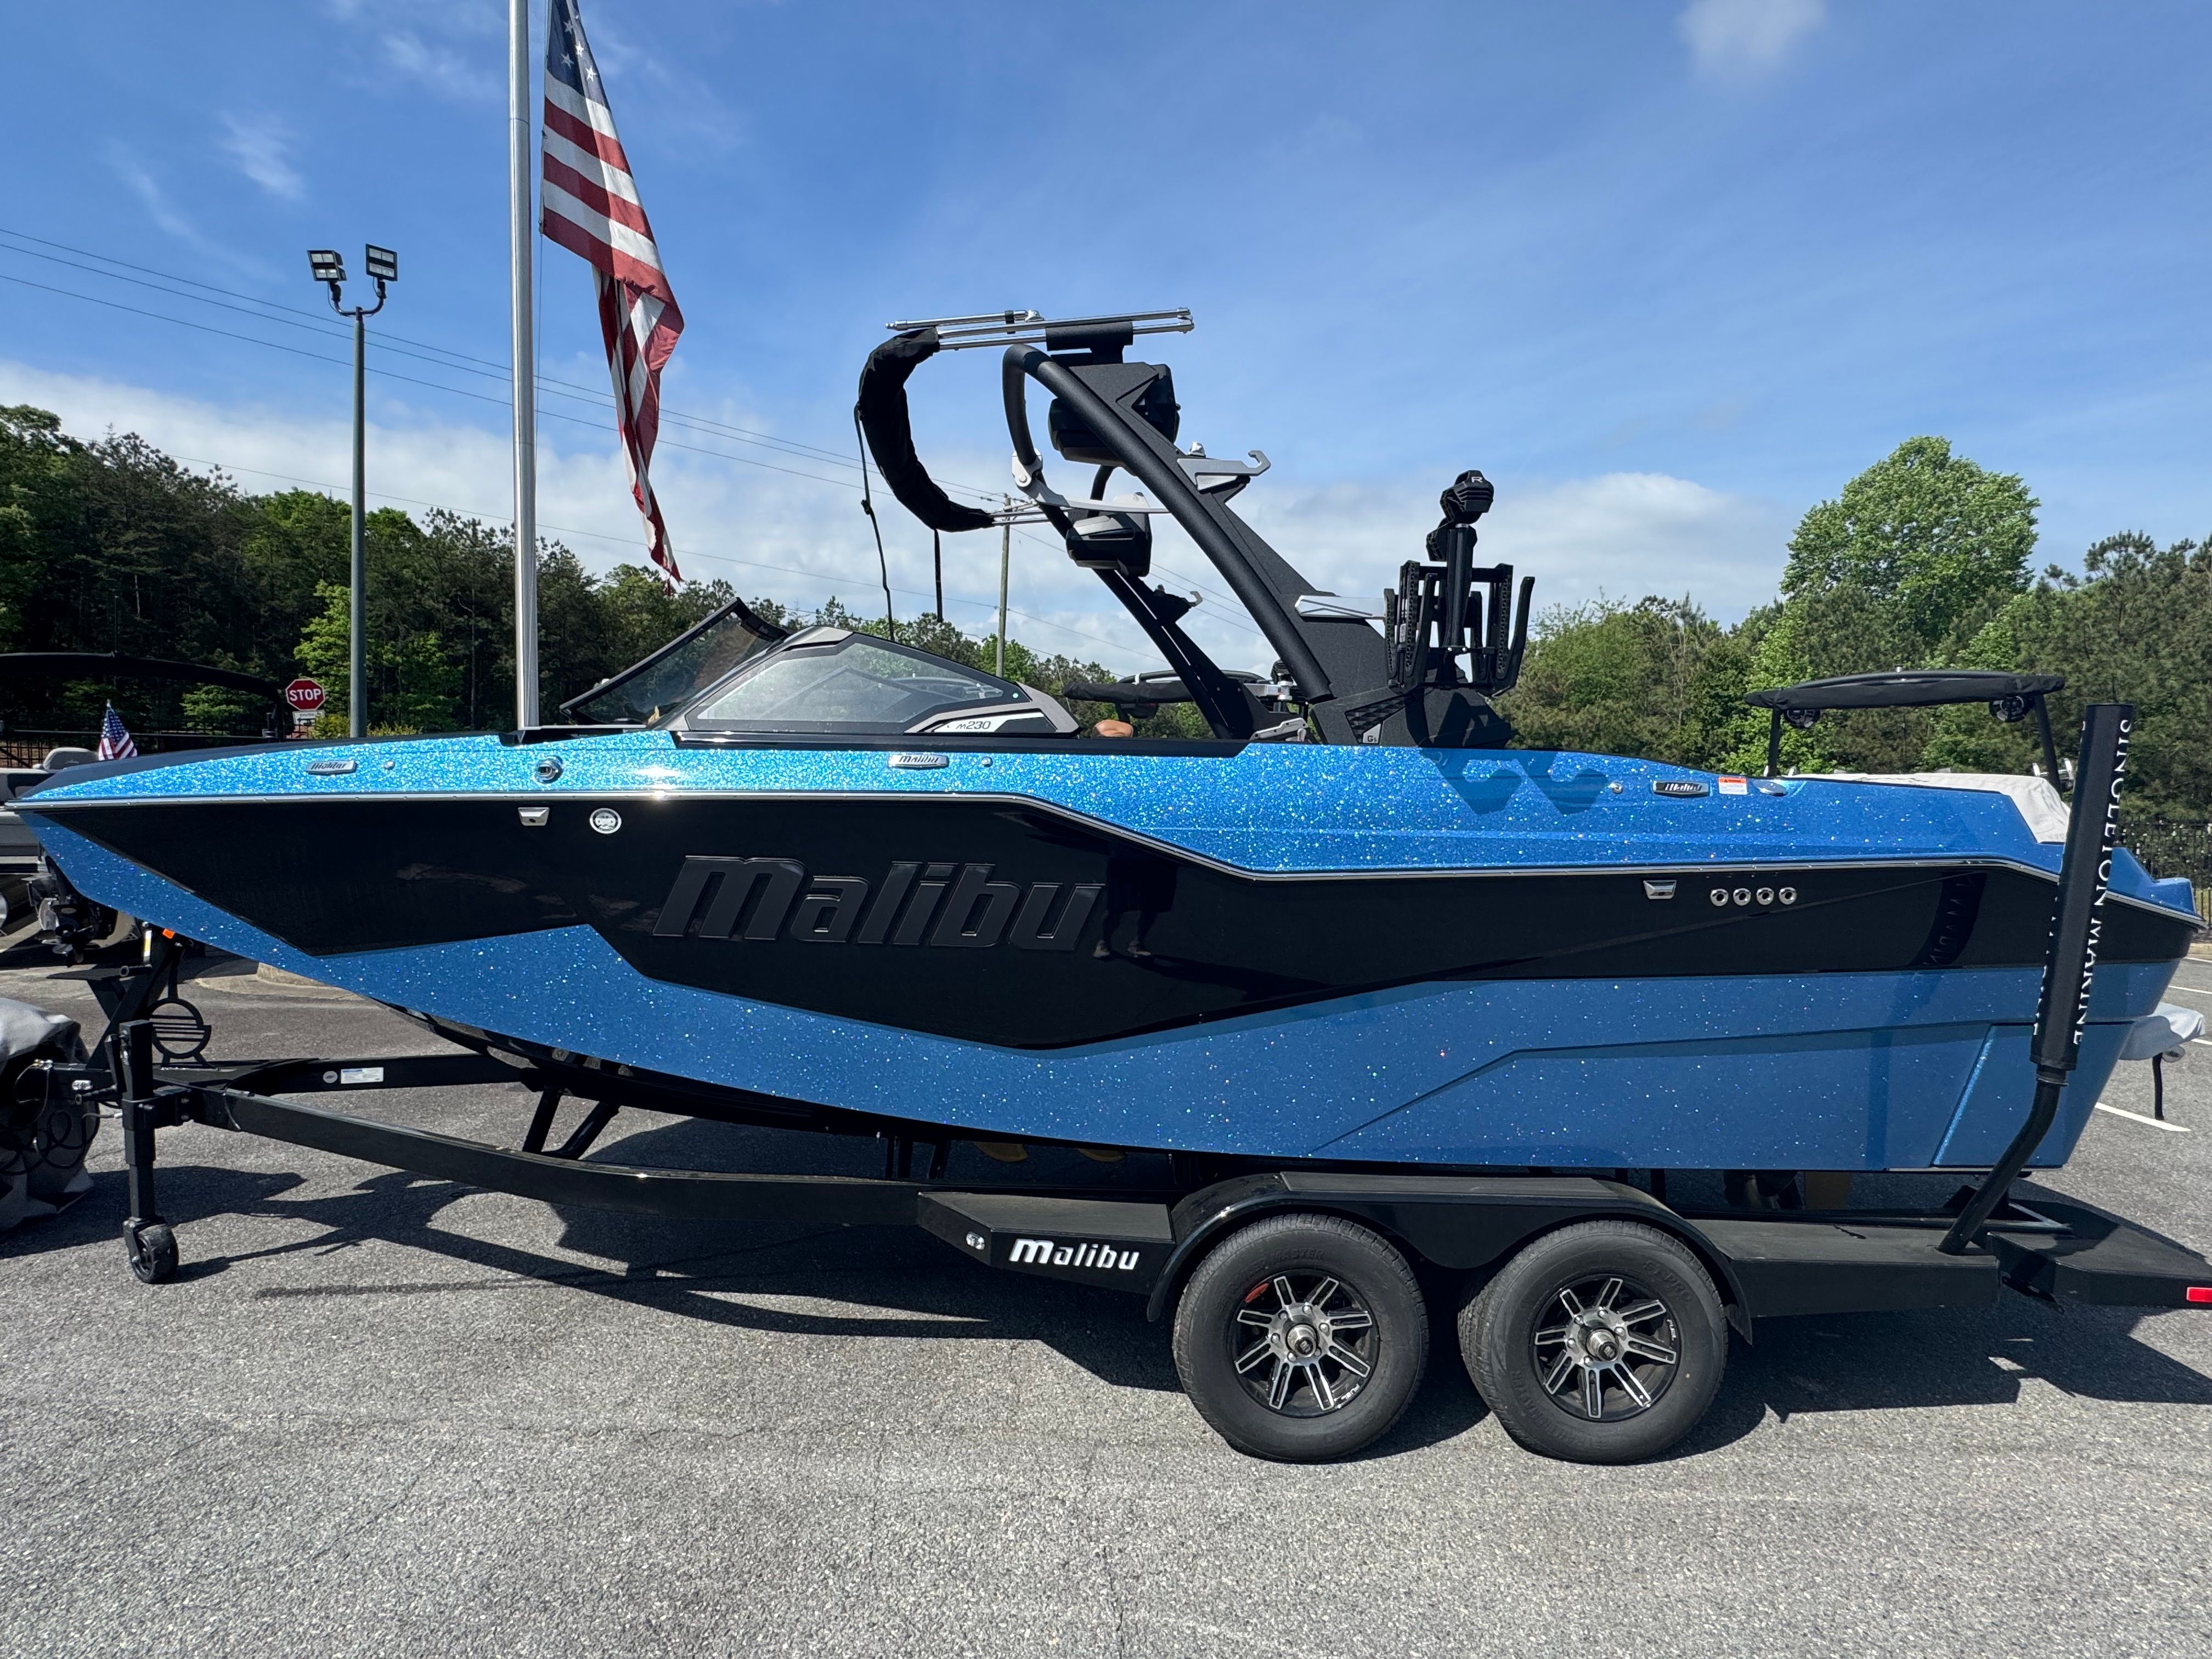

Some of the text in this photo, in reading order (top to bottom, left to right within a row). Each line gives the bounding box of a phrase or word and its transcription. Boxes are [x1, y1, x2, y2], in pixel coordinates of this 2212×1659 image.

[289, 689, 321, 701] STOP
[653, 855, 1105, 950] Malibu
[1009, 1238, 1139, 1271] Malibu
